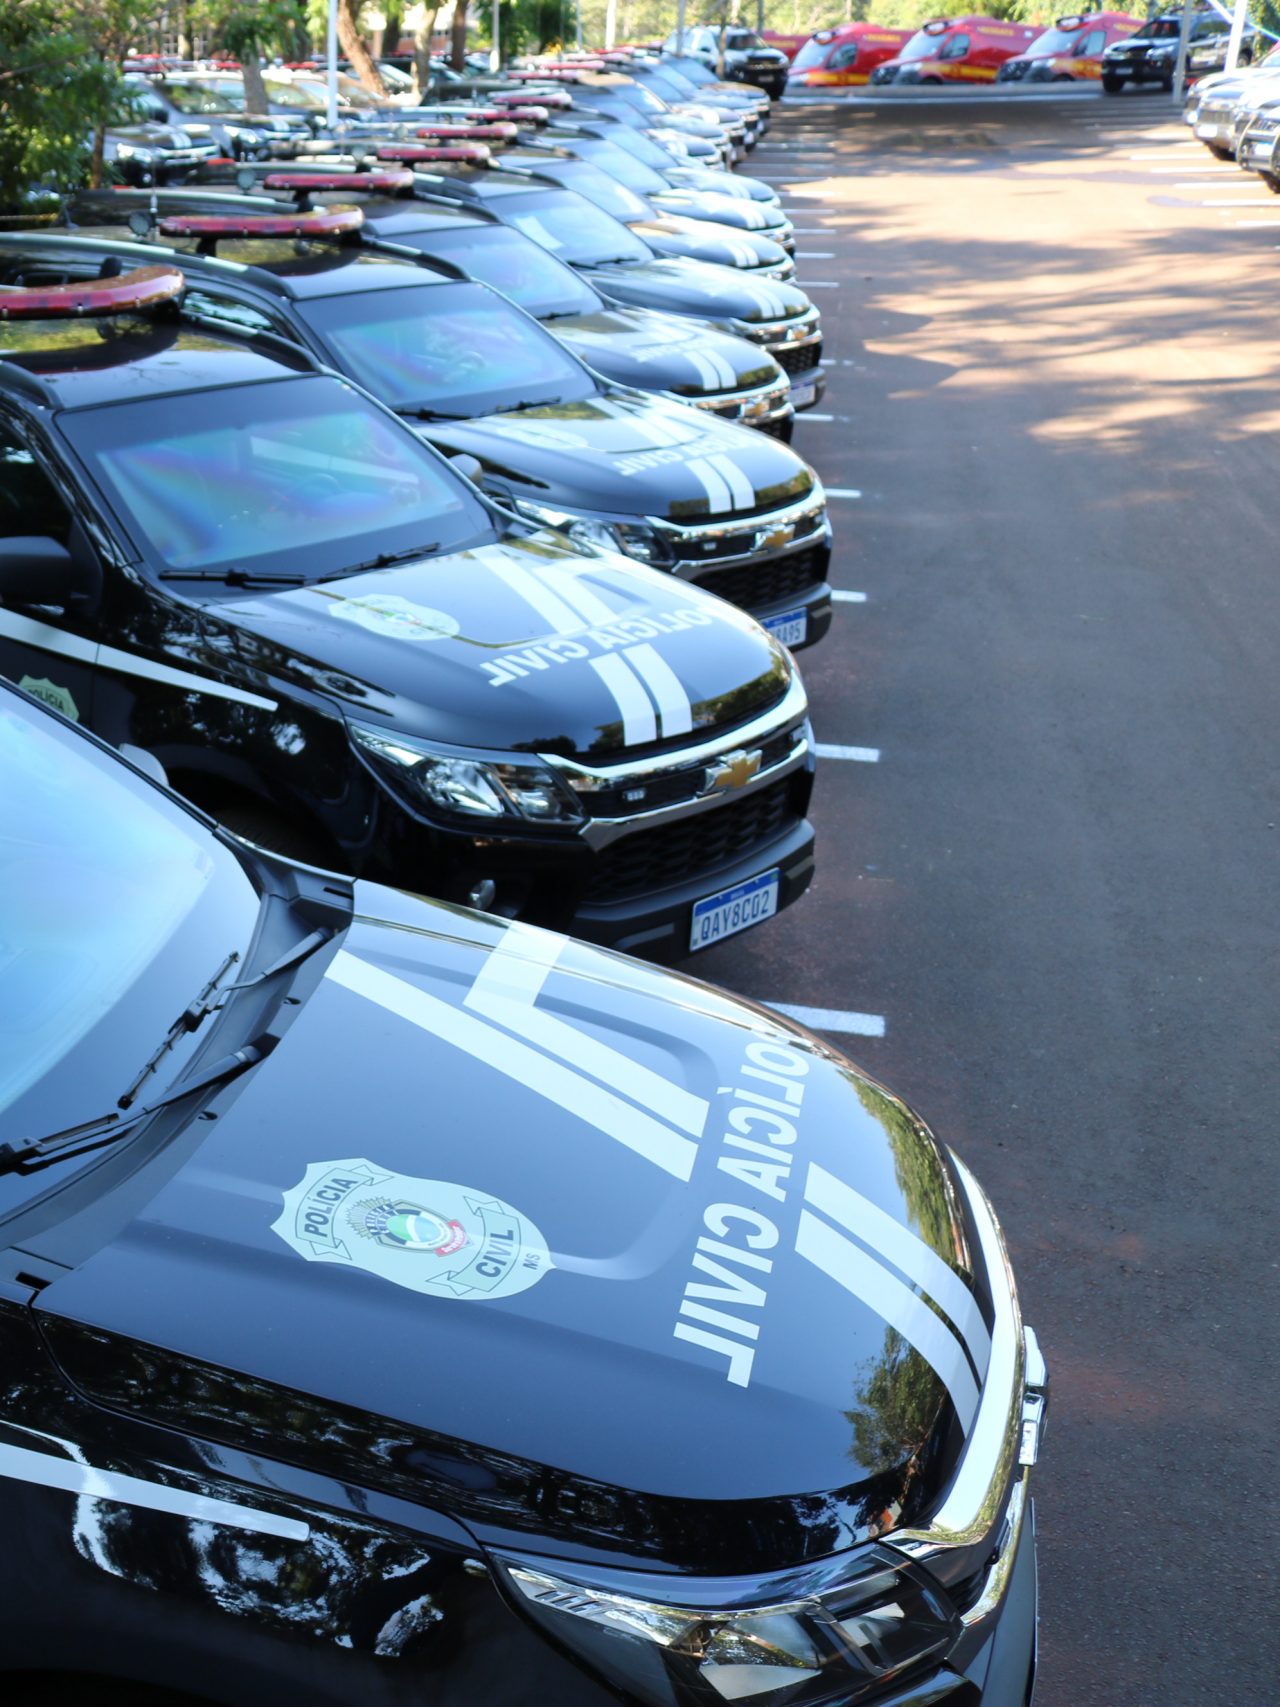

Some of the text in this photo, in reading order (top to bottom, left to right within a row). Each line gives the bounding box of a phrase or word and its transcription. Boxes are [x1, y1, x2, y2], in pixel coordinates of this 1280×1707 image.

[700, 889, 771, 941] QAY8C02
[304, 1176, 359, 1239] POLÍCIA
[475, 1228, 515, 1279] CIVIL
[522, 1252, 542, 1271] MS
